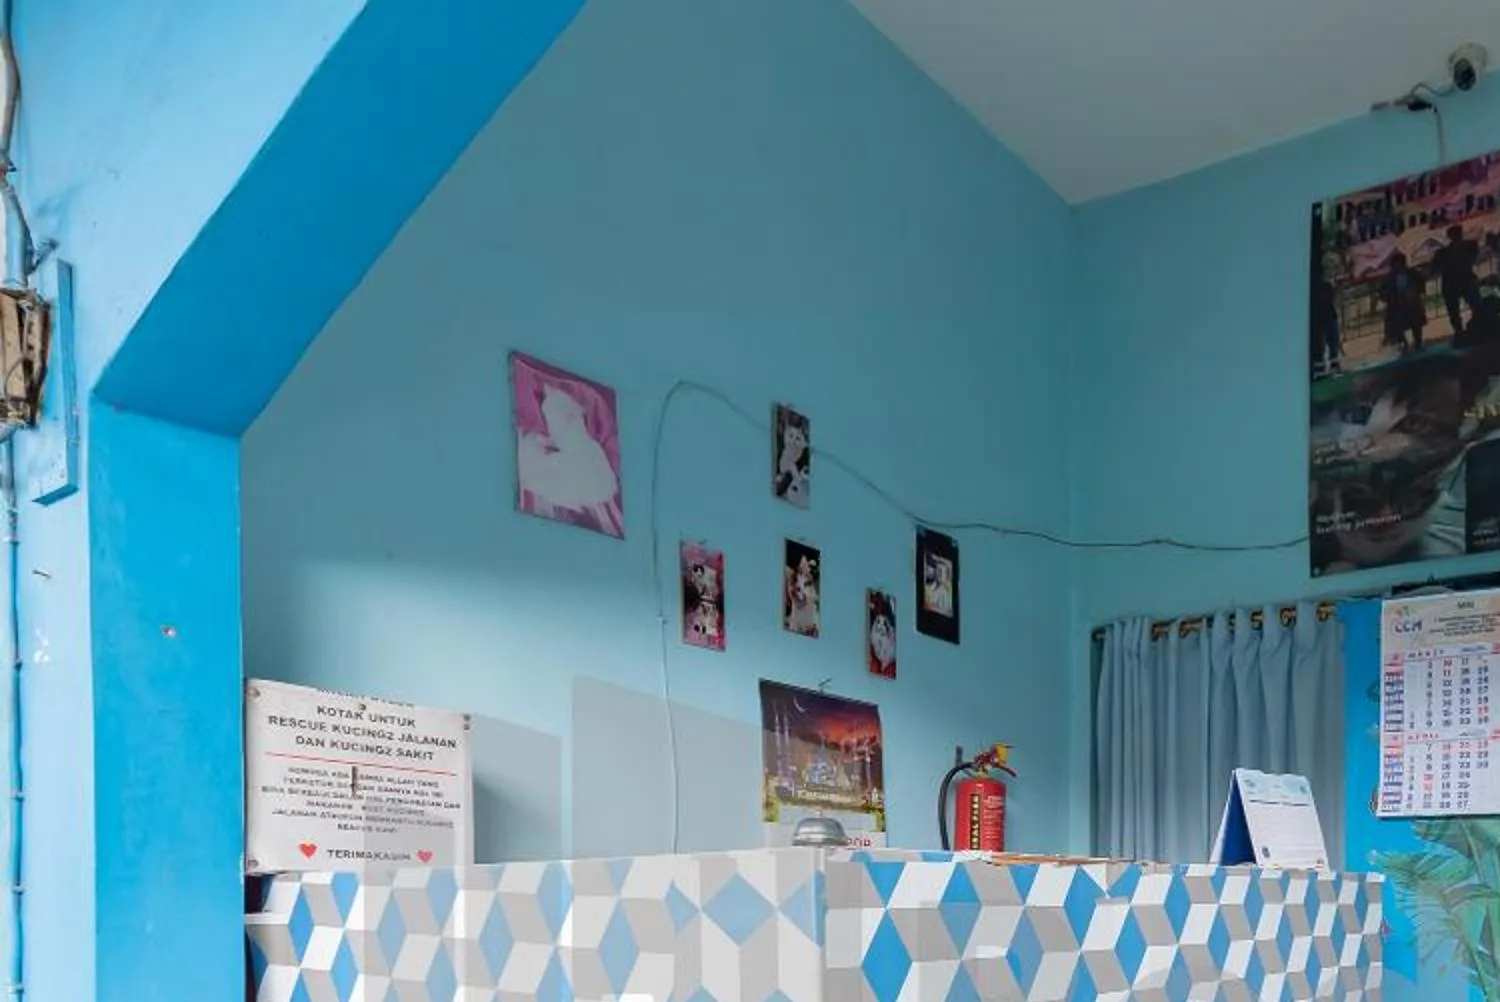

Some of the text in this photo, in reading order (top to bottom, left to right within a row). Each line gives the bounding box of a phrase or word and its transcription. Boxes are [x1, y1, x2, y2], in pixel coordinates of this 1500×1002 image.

[317, 705, 416, 728] KOTAK UNTUK
[268, 715, 327, 733] RESCUE
[397, 732, 457, 749] JALANAN
[296, 735, 325, 748] DAN
[395, 747, 435, 761] SAKIT
[327, 849, 411, 861] TERIMAKASIH
